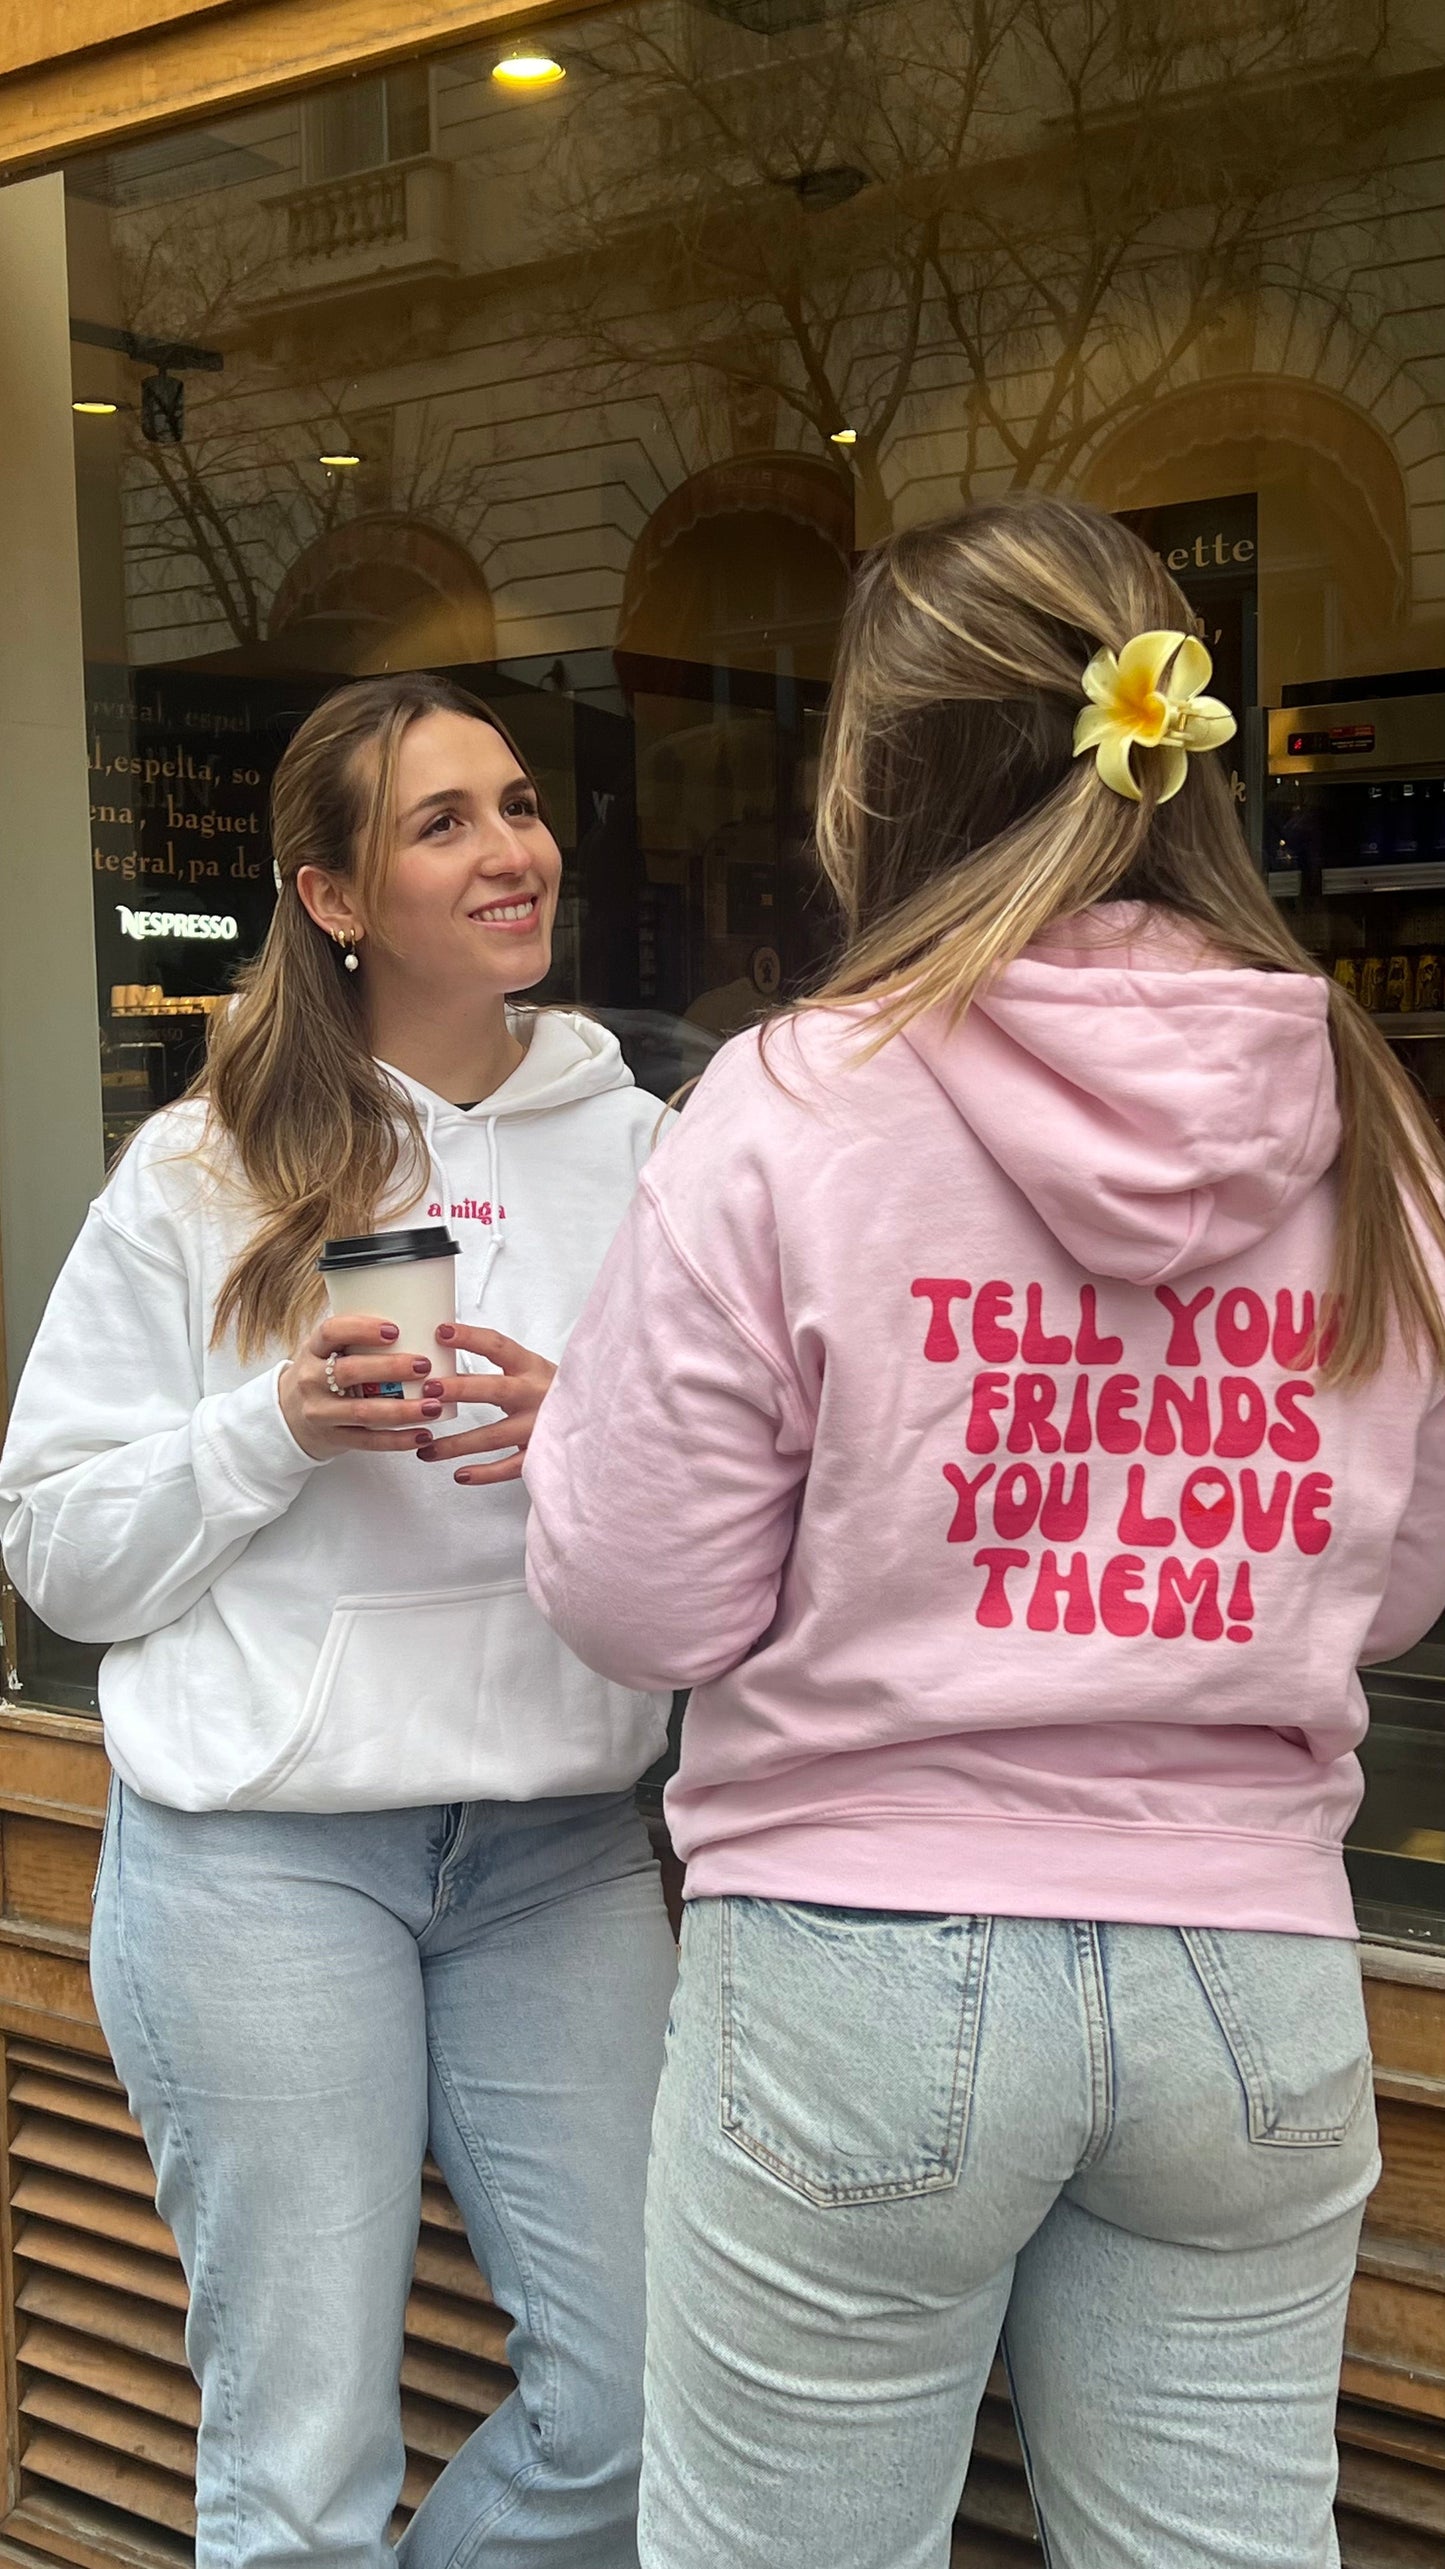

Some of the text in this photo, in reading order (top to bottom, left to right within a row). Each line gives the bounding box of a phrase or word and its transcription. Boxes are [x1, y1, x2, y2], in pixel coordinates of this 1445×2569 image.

[1154, 532, 1255, 571] ette
[231, 768, 261, 786] so
[166, 794, 259, 838] baguet
[230, 845, 261, 880] de
[116, 904, 239, 940] NESPRESSO
[911, 1278, 1124, 1365] TELL
[966, 1371, 1321, 1464] FRIENDS
[943, 1462, 1334, 1556] YOU LOVE
[974, 1548, 1256, 1644] THEM!
